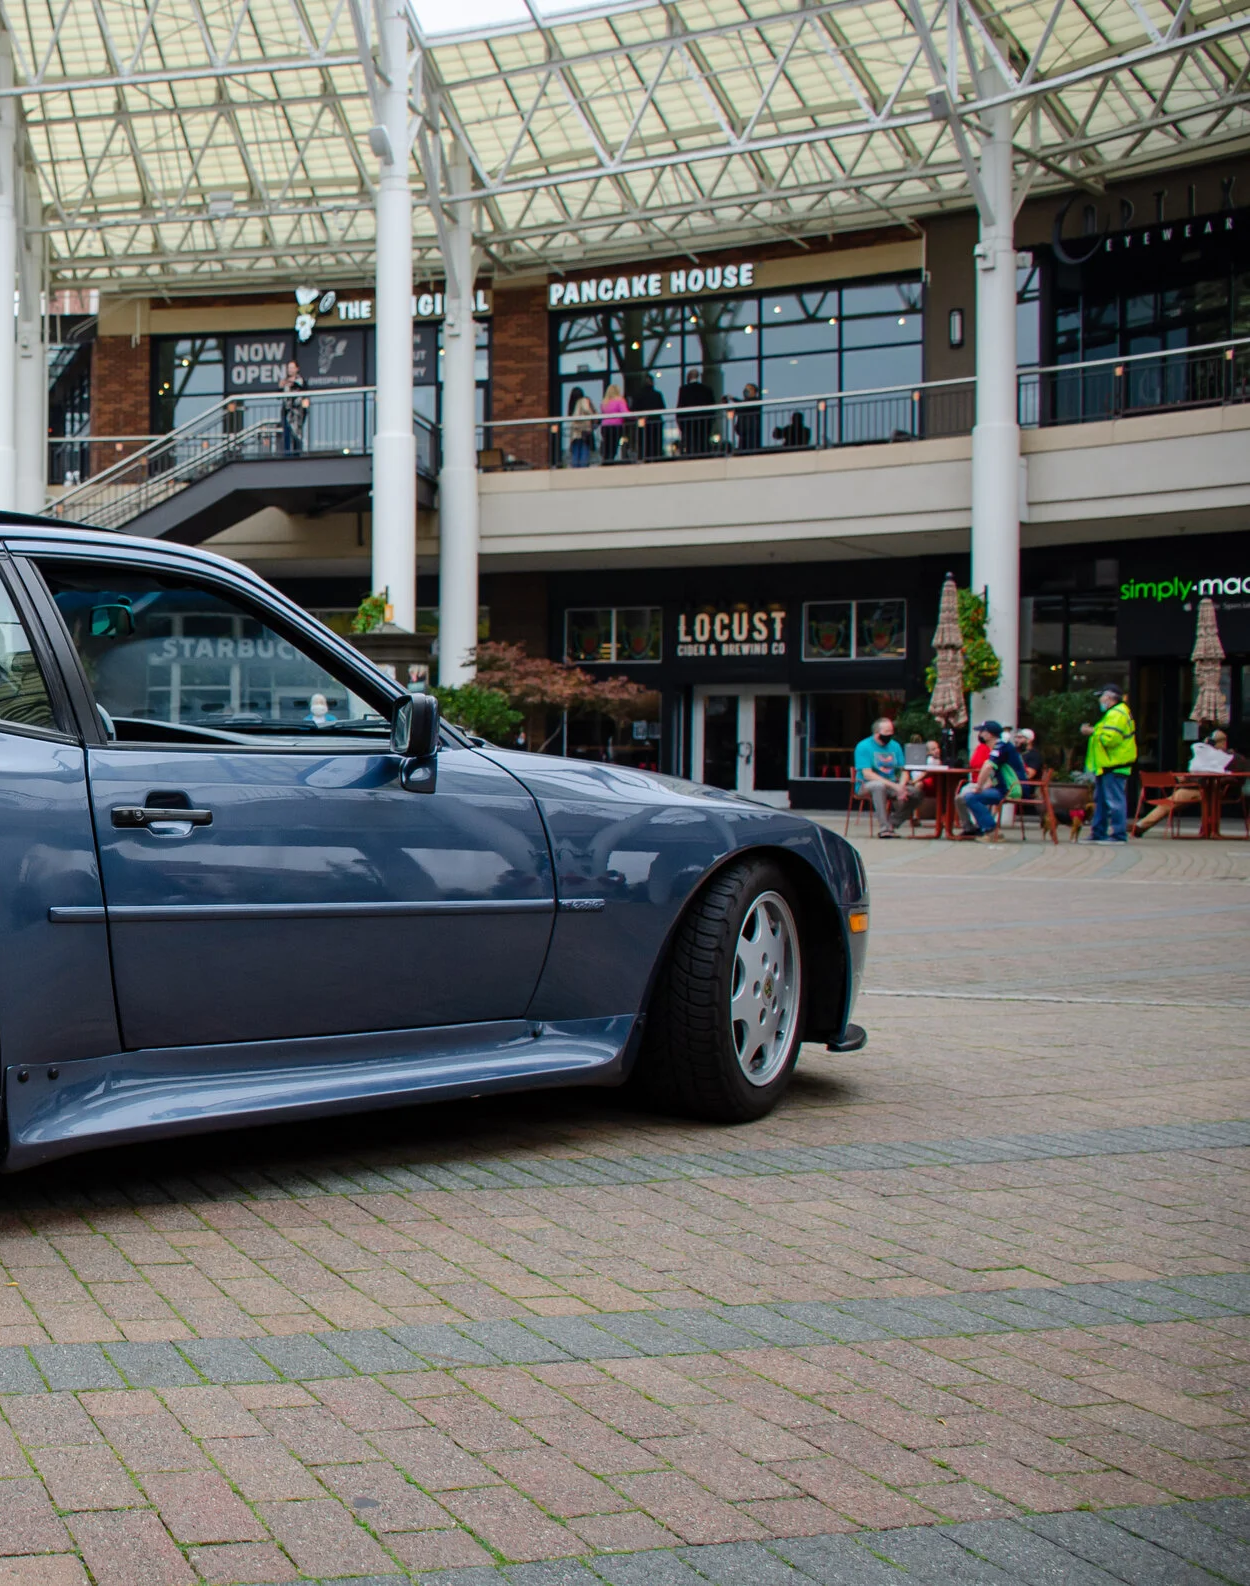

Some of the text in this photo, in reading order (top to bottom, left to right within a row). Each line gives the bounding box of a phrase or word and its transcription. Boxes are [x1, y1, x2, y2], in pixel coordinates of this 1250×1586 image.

[1105, 217, 1235, 252] EYEWEAR
[550, 263, 754, 306] PANCAKE HOUSE
[337, 300, 372, 320] THE
[234, 342, 286, 363] NOW
[231, 363, 287, 385] OPEN
[678, 611, 786, 642] LOCUST
[676, 643, 706, 656] CIDER
[721, 642, 768, 656] BREWING
